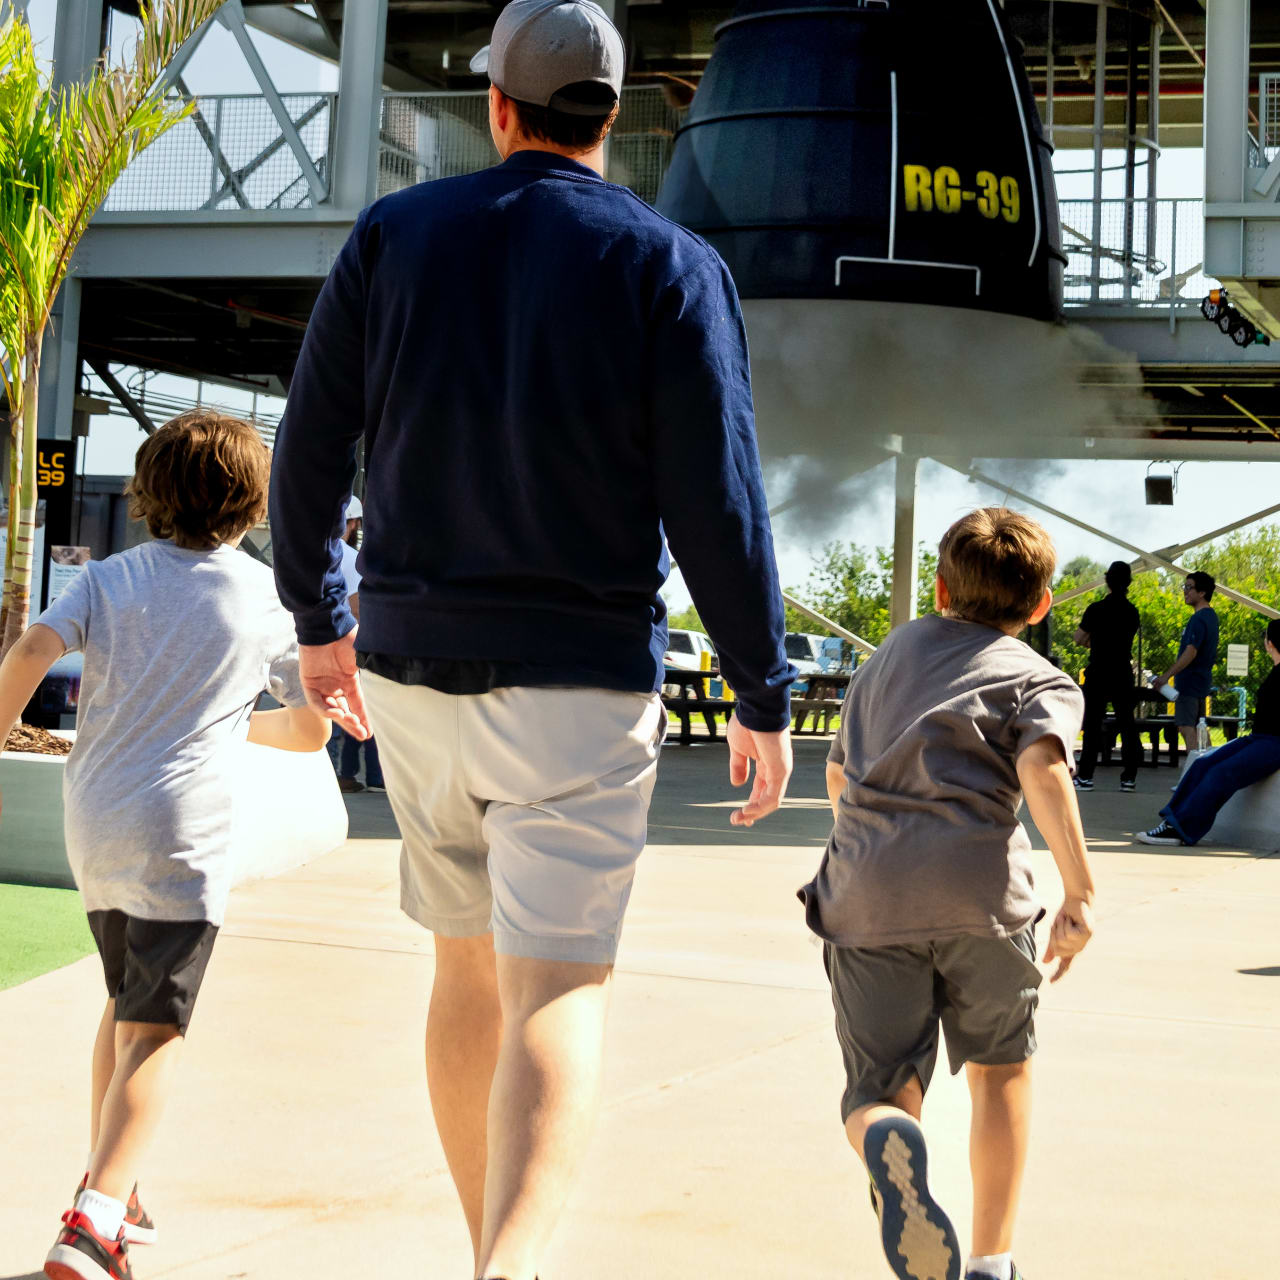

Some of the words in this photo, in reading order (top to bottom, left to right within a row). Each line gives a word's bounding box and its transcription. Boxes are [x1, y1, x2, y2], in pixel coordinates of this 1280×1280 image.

[903, 164, 1020, 223] RG-39
[38, 452, 65, 469] LC
[37, 469, 65, 487] 39
